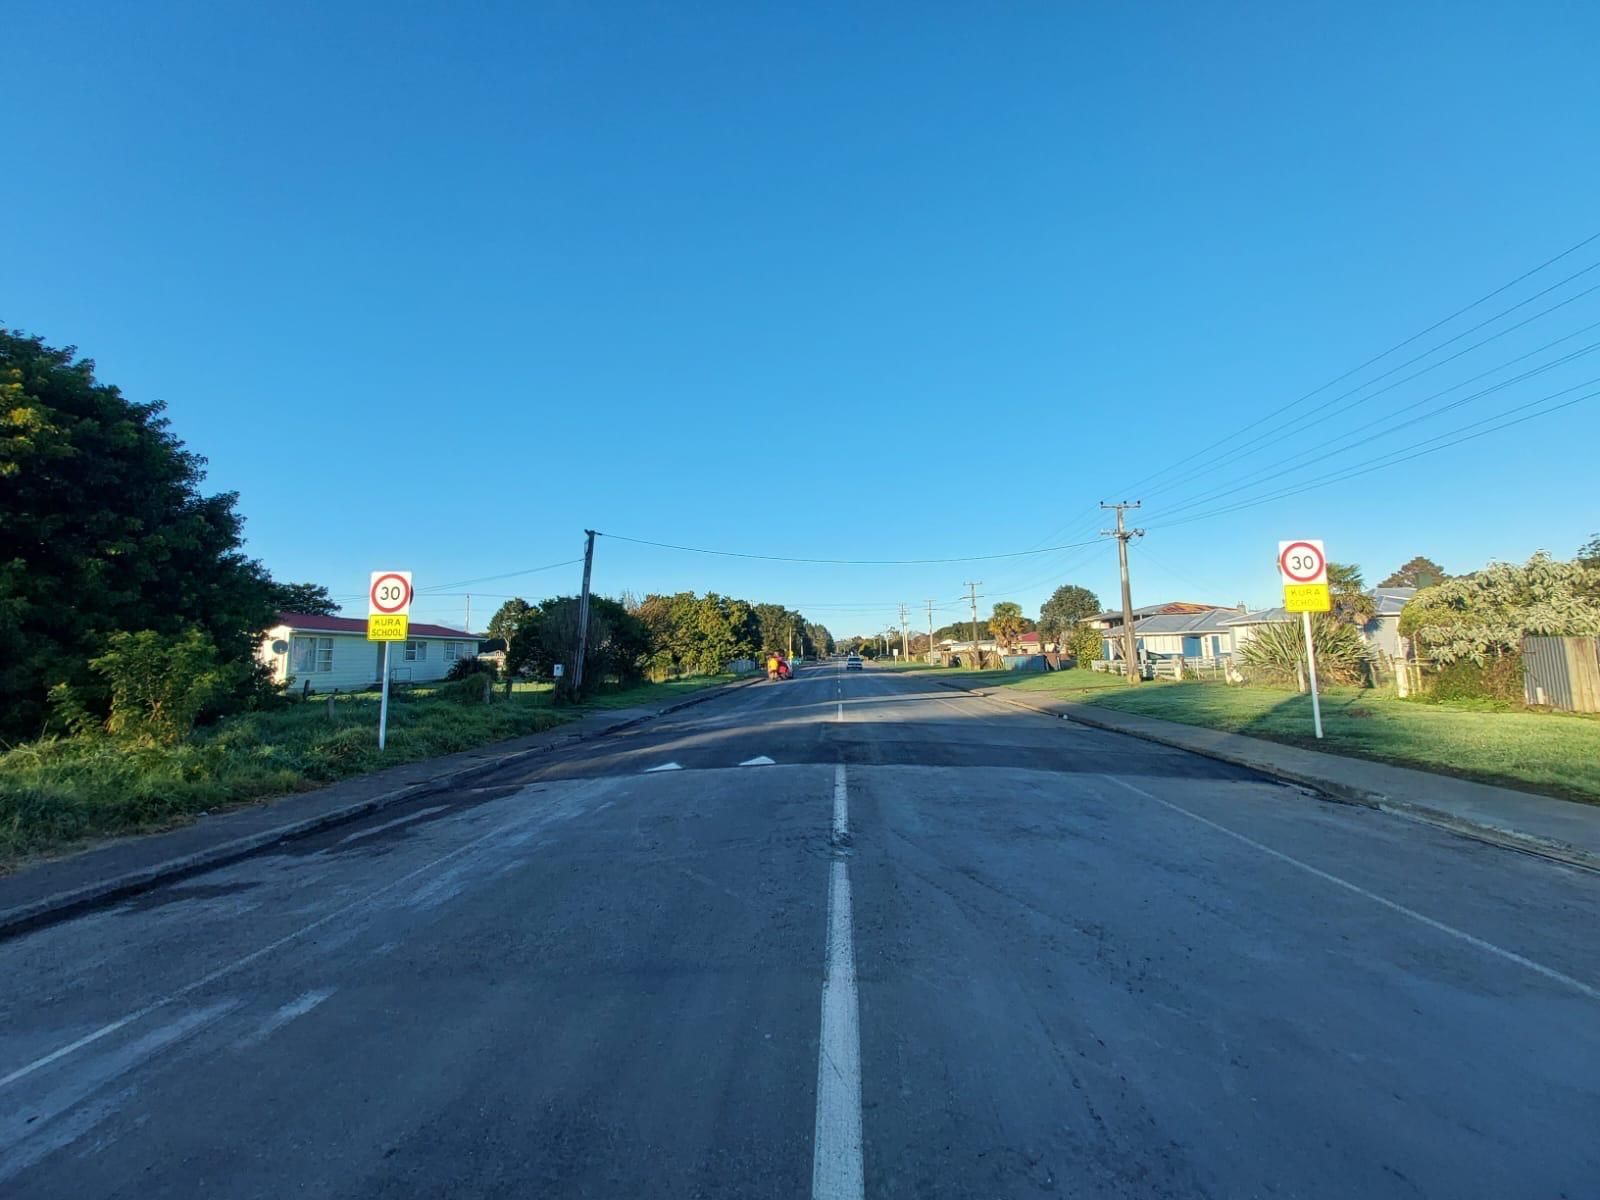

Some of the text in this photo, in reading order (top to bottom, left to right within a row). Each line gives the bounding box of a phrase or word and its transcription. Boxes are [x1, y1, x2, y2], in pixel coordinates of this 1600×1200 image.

[1292, 555, 1314, 570] 30
[380, 586, 401, 600] 30
[1290, 588, 1321, 597] KURA
[374, 618, 402, 627] KURA
[371, 628, 403, 637] SCHOOL
